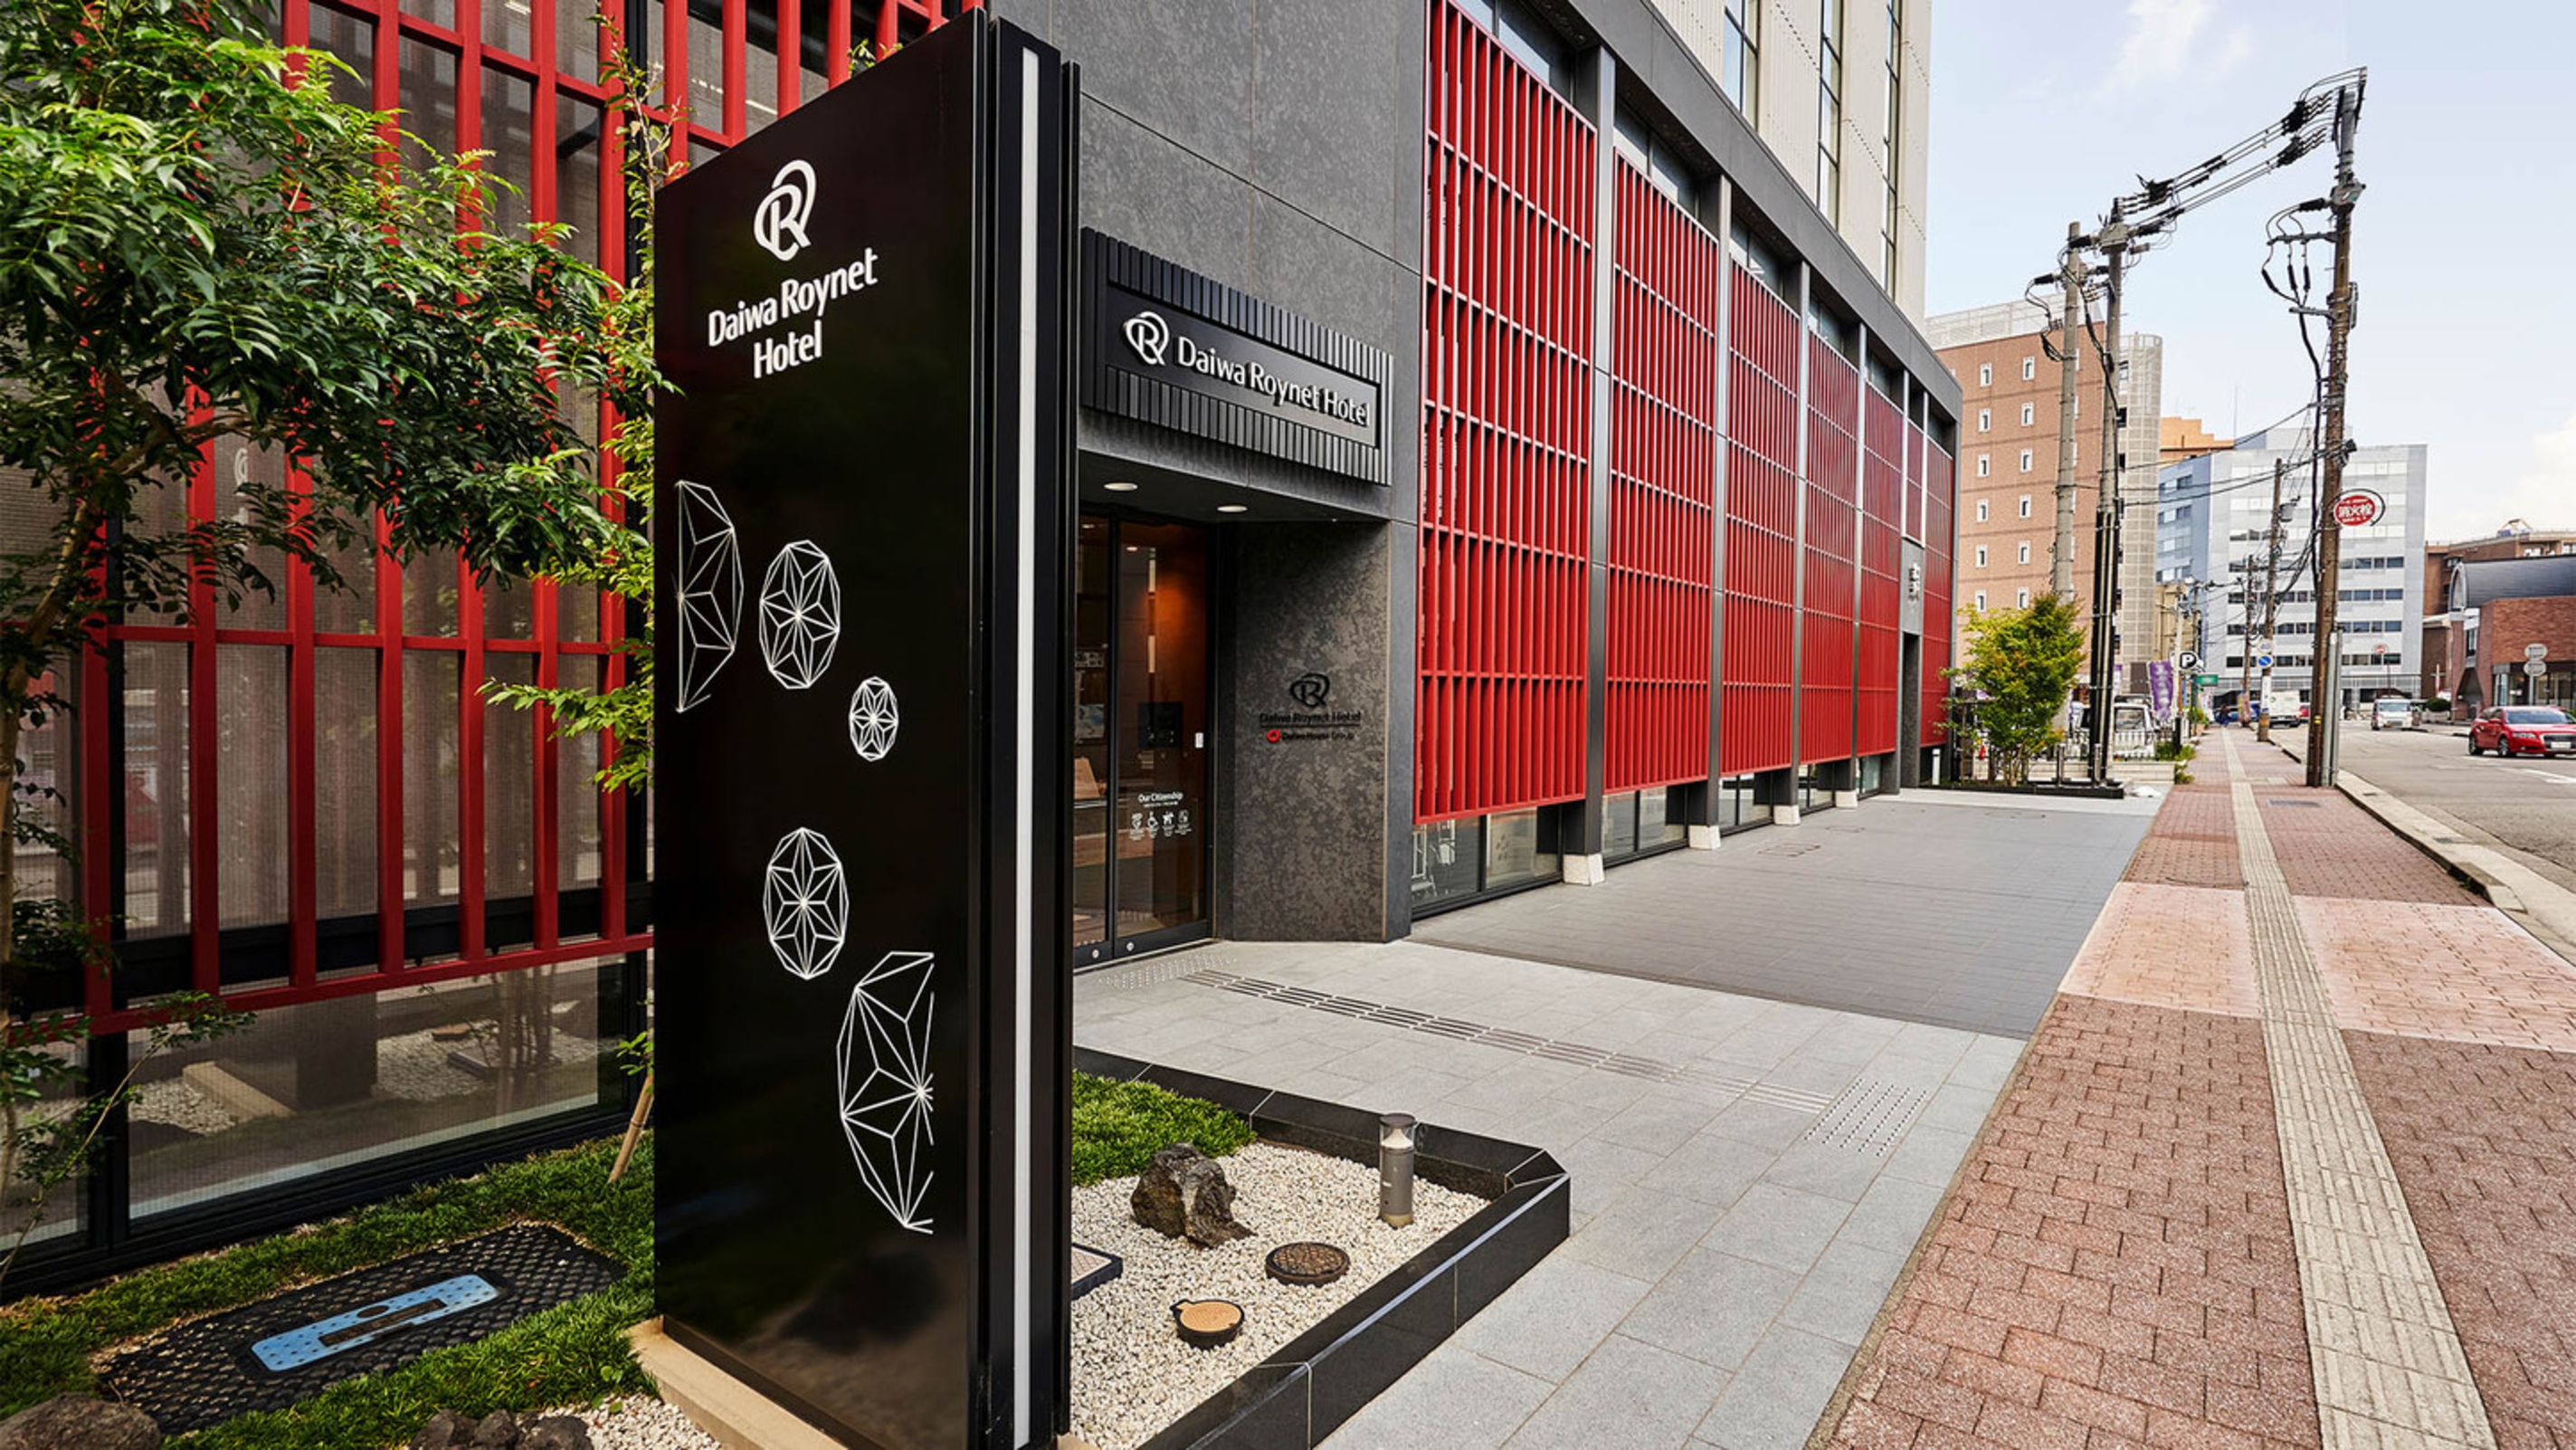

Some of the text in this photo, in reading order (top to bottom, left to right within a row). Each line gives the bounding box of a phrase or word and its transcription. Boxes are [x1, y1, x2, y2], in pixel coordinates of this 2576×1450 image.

[708, 247, 879, 347] Daiwa Roynet
[754, 320, 822, 378] Hotel
[1178, 337, 1245, 386] Daiwa
[1249, 361, 1320, 406] Roynet
[1323, 388, 1371, 427] Hotel
[1259, 711, 1361, 726] Daiwa Roynet Hotel
[1137, 793, 1150, 803] Our
